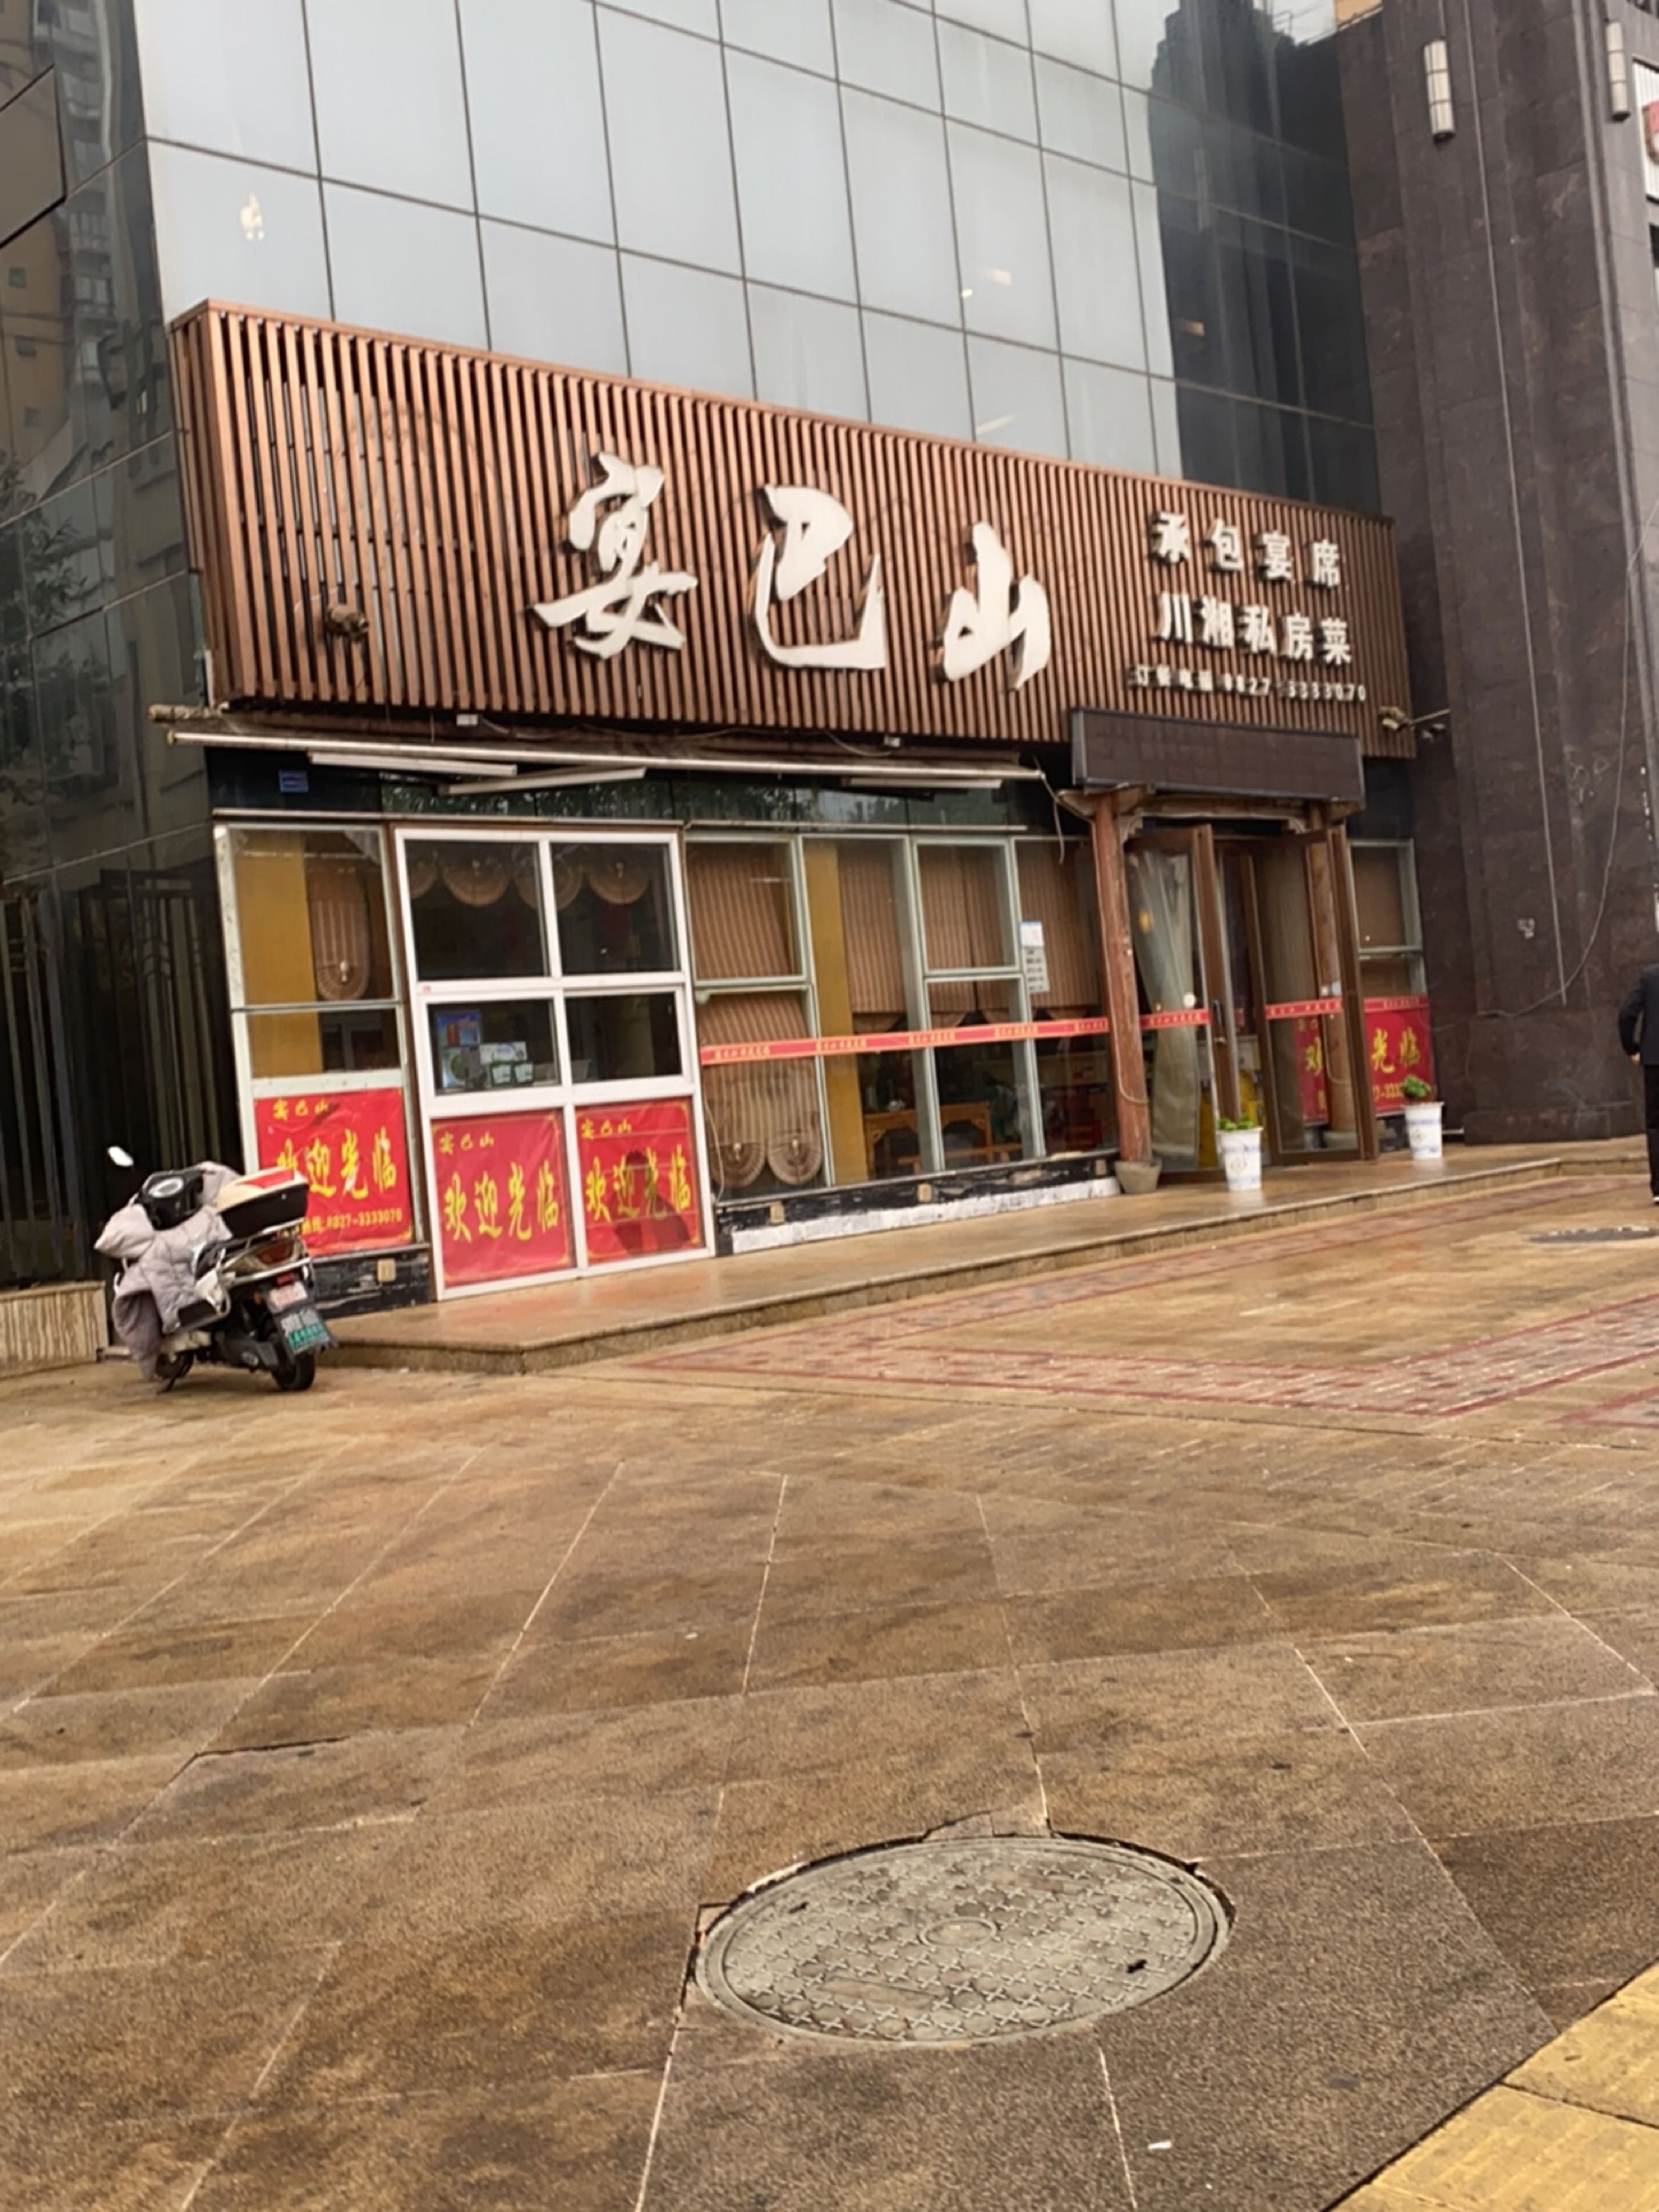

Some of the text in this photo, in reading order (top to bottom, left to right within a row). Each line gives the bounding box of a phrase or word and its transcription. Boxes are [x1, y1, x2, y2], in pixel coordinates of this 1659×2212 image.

[1151, 511, 1342, 588] 承包宴席
[1156, 590, 1352, 667] 川湘私房菜
[443, 1159, 559, 1244] 欢迎光临
[585, 1143, 691, 1224] 欢迎光临
